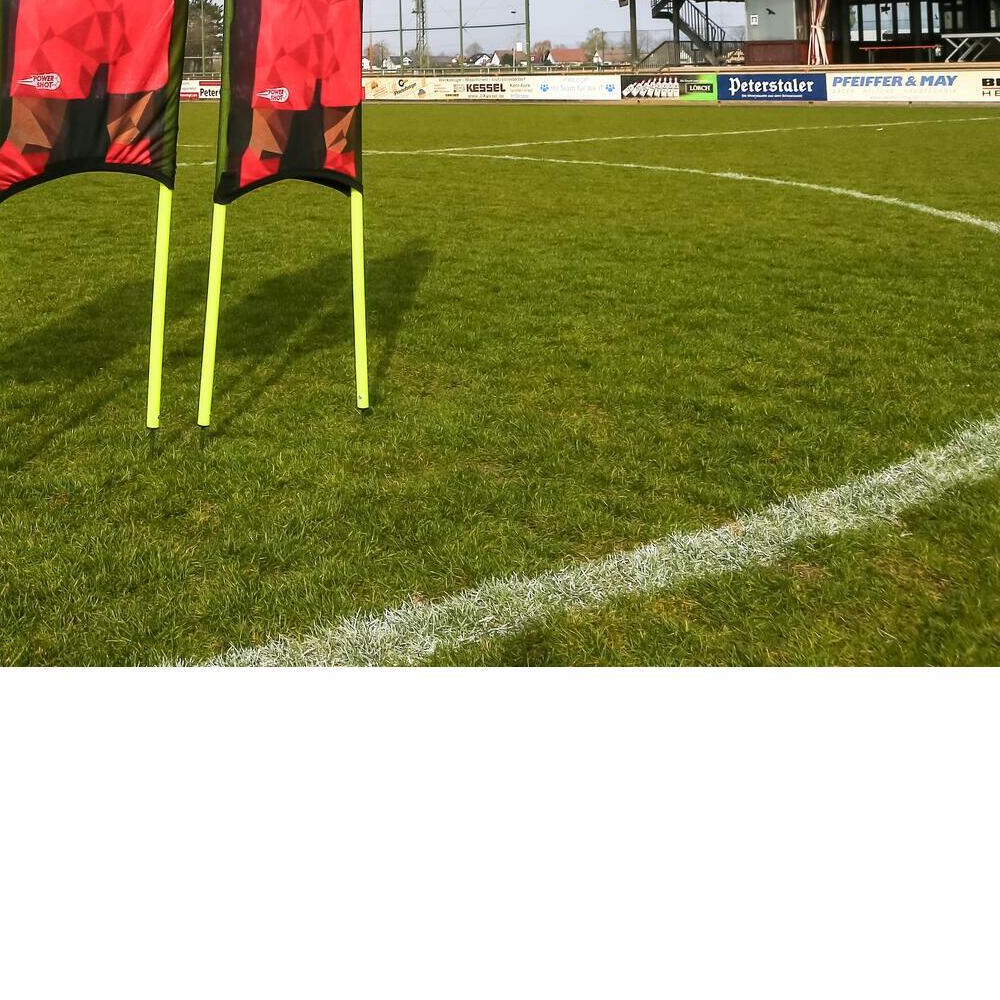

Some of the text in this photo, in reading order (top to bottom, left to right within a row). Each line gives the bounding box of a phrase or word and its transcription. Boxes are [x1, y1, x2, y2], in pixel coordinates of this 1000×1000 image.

[729, 78, 815, 96] Peterstaler
[832, 75, 958, 87] PFEIFFER & MAY
[466, 83, 506, 92] KESSEL
